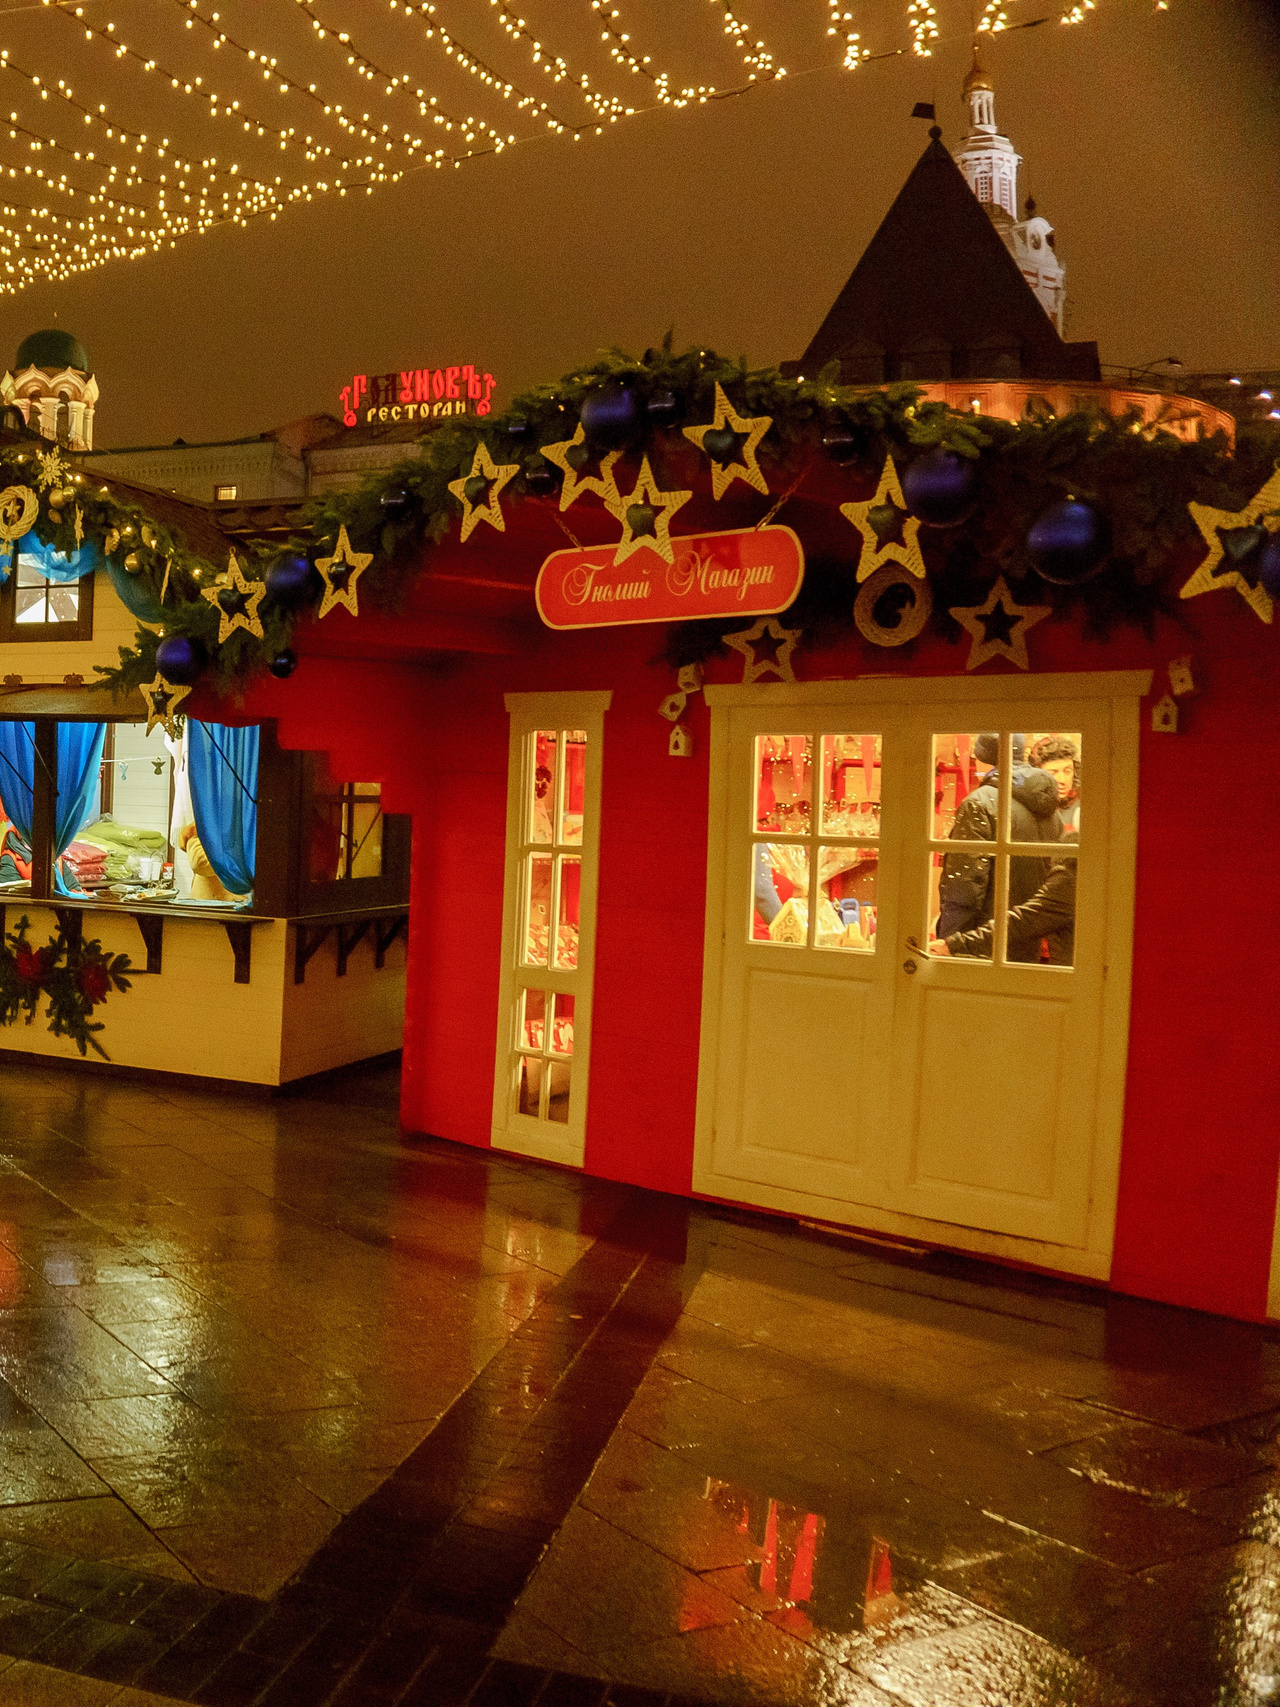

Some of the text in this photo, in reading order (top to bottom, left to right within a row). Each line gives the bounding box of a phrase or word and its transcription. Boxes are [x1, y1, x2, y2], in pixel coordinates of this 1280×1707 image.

[367, 400, 466, 423] РЕСТОРАН
[562, 550, 775, 606] Гномий Магазин
